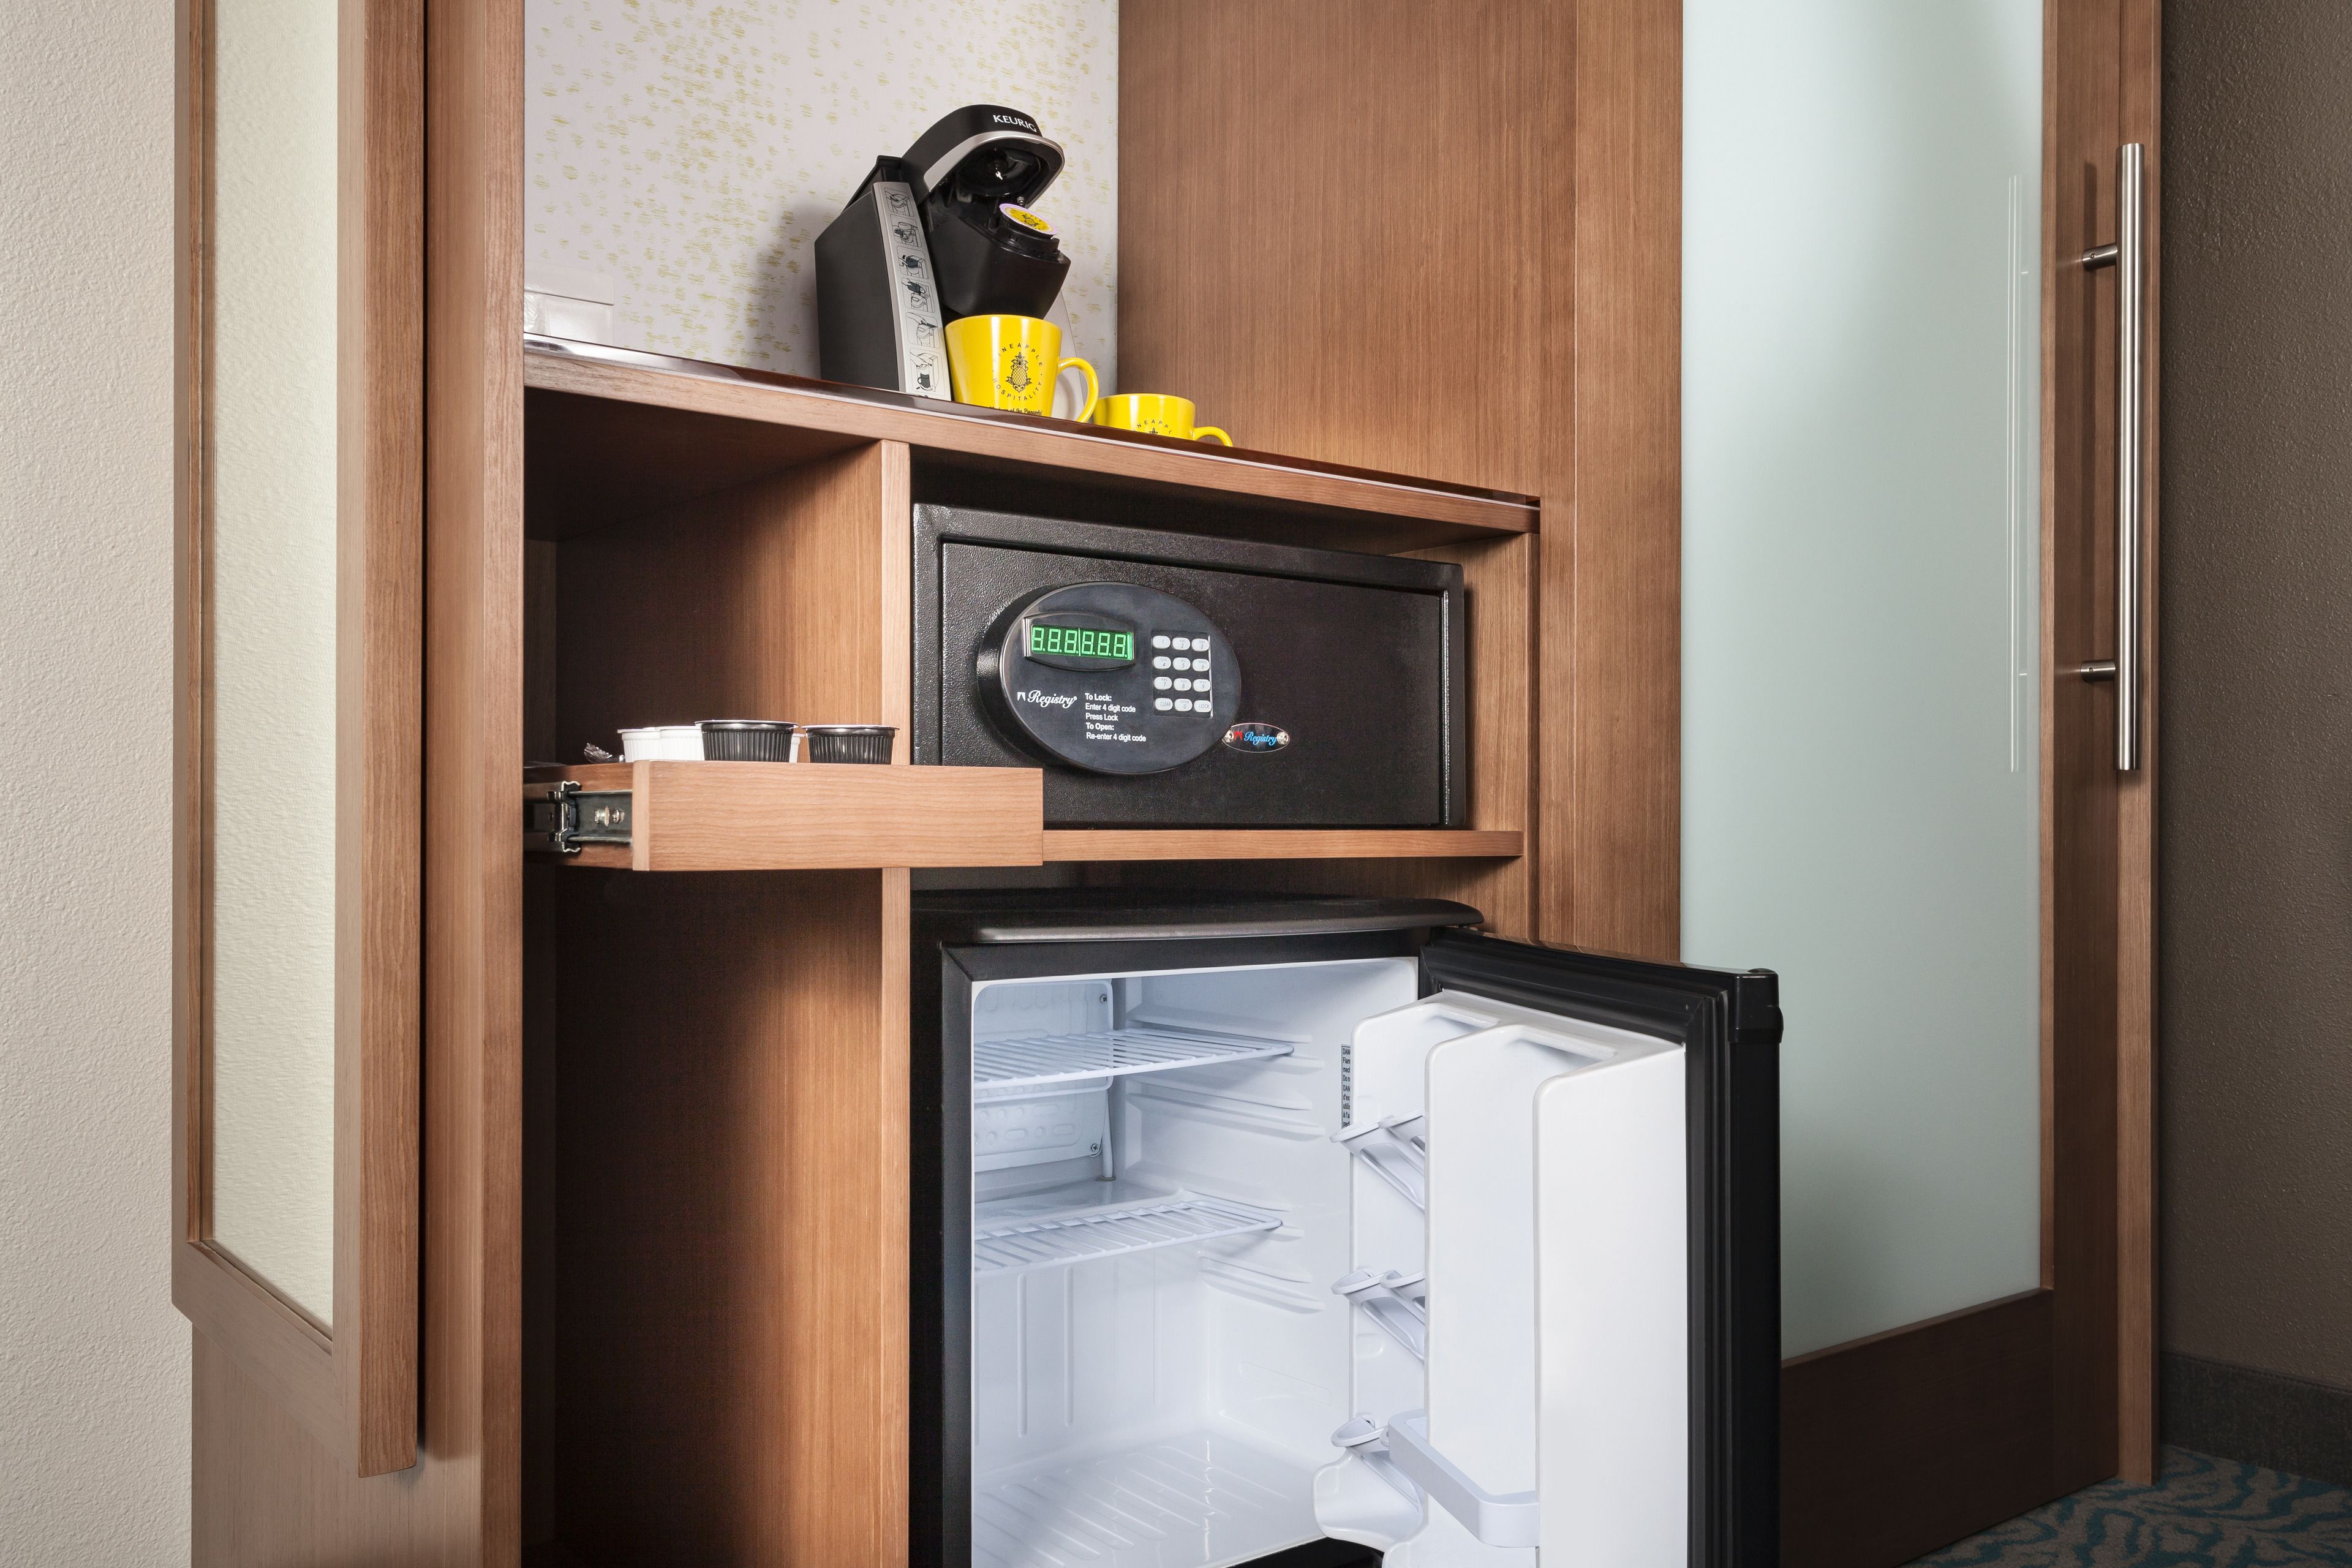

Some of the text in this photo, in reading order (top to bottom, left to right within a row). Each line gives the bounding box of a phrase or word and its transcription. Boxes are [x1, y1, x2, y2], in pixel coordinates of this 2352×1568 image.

[993, 115, 1037, 132] KEURIG
[993, 377, 1041, 401] HOSPITALITY
[1107, 704, 1121, 713] digit
[1095, 723, 1115, 731] Open:
[1118, 734, 1131, 742] digit
[1244, 731, 1277, 746] Registry
